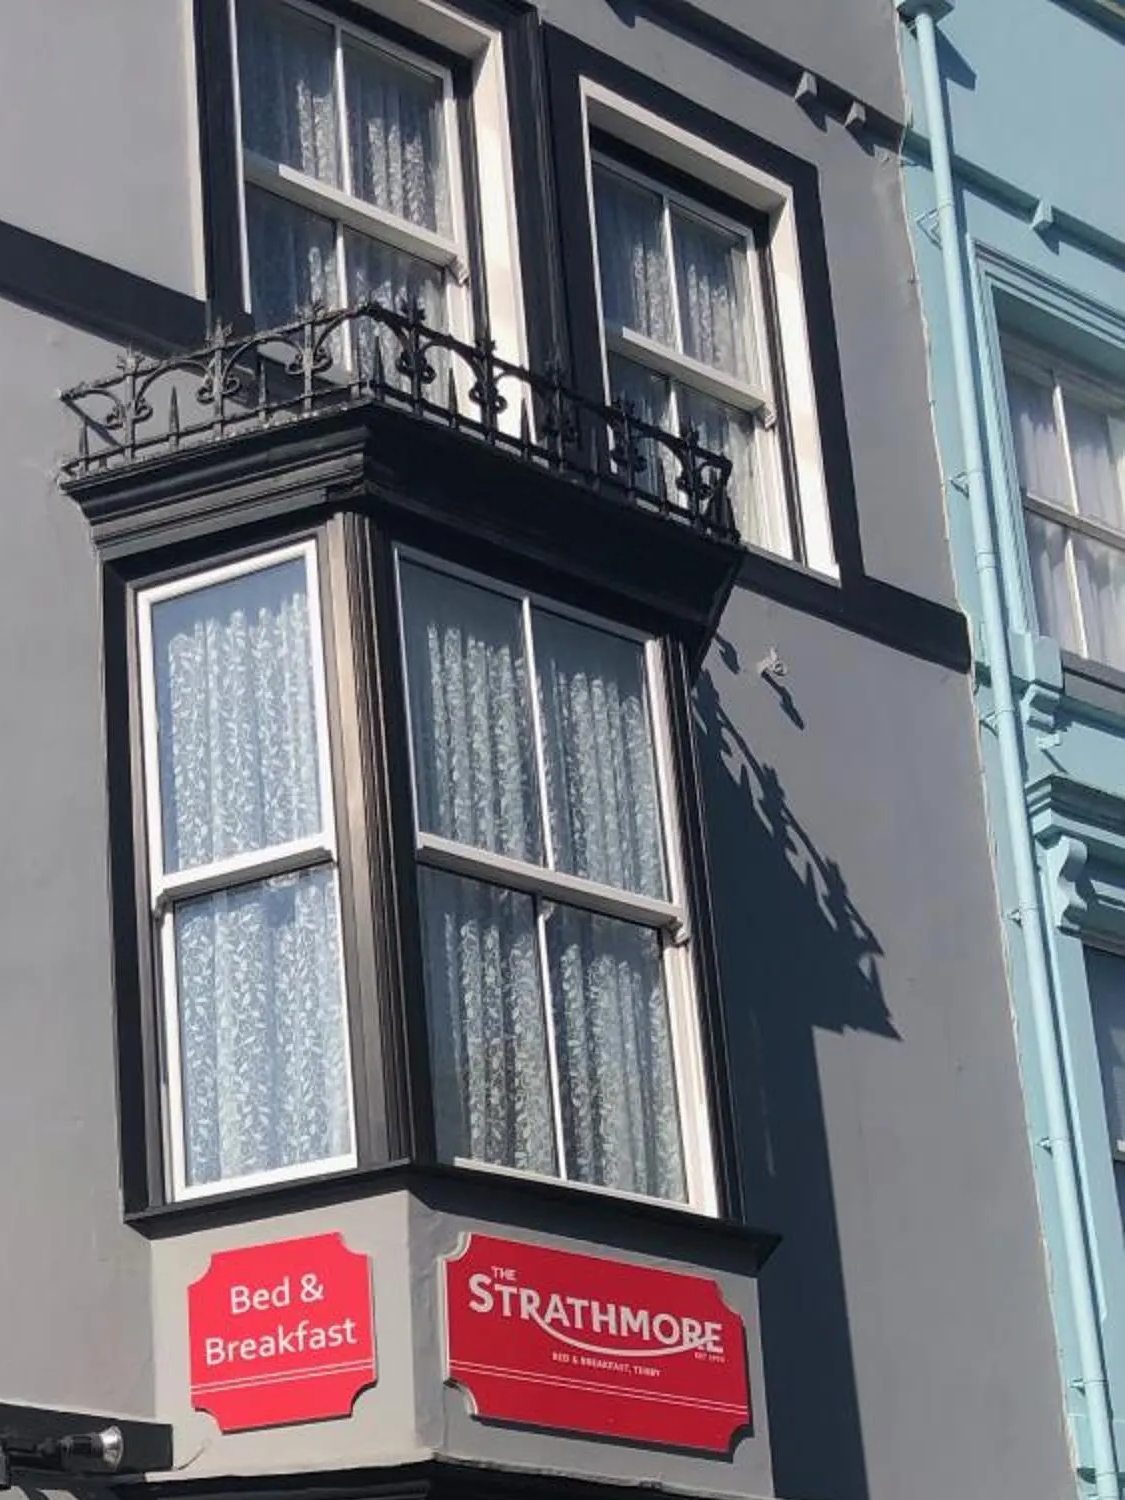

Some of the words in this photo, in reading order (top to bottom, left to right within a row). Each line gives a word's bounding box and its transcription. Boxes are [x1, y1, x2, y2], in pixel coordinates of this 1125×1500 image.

[491, 1265, 517, 1282] THE
[230, 1275, 290, 1315] Bed
[300, 1273, 325, 1303] &
[205, 1318, 357, 1366] Breakfast
[552, 1351, 570, 1363] BED
